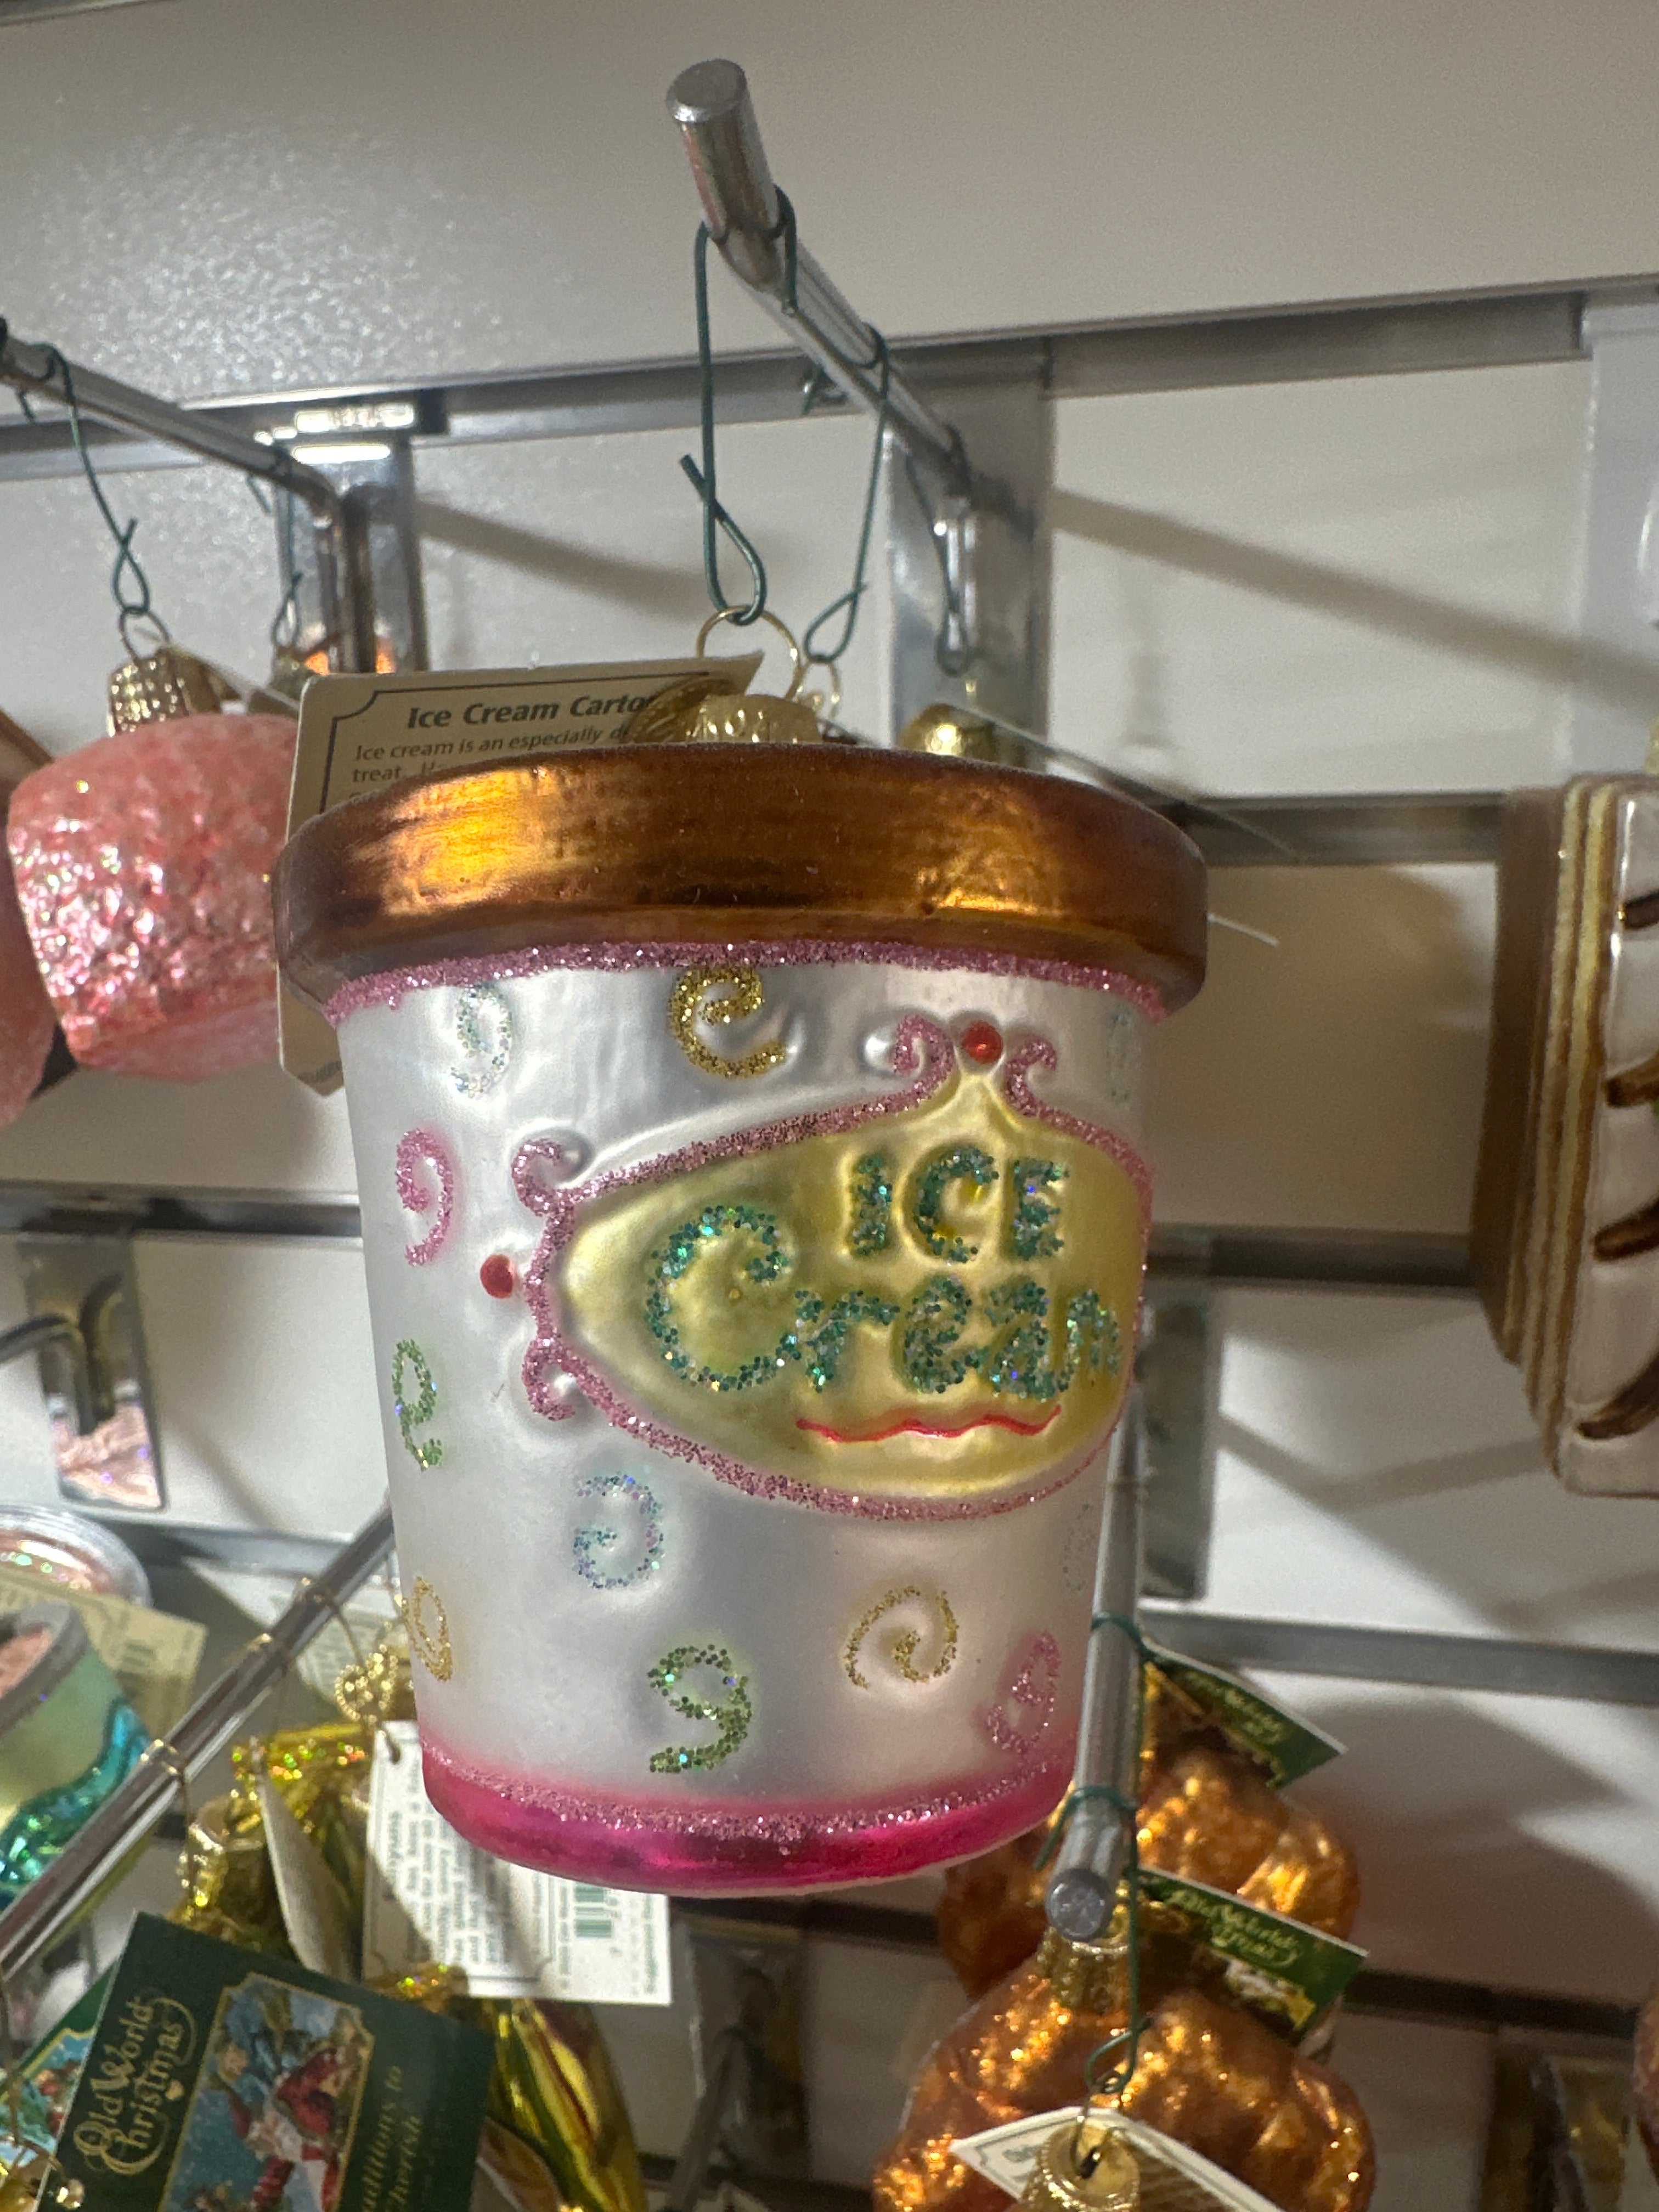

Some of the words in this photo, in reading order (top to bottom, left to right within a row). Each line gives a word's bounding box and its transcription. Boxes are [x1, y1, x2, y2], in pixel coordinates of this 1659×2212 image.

[354, 745, 385, 761] Ice
[390, 741, 454, 758] cream
[459, 738, 476, 754] is
[479, 738, 504, 751] an
[509, 725, 603, 751] especially
[408, 707, 452, 729] Ice
[463, 701, 560, 725] Cream
[569, 693, 651, 716] Carto
[849, 1145, 1071, 1265] ICE
[643, 1203, 1122, 1403] Cream
[89, 1995, 155, 2090] World
[100, 2002, 196, 2176] Christmas
[72, 2091, 124, 2164] Old
